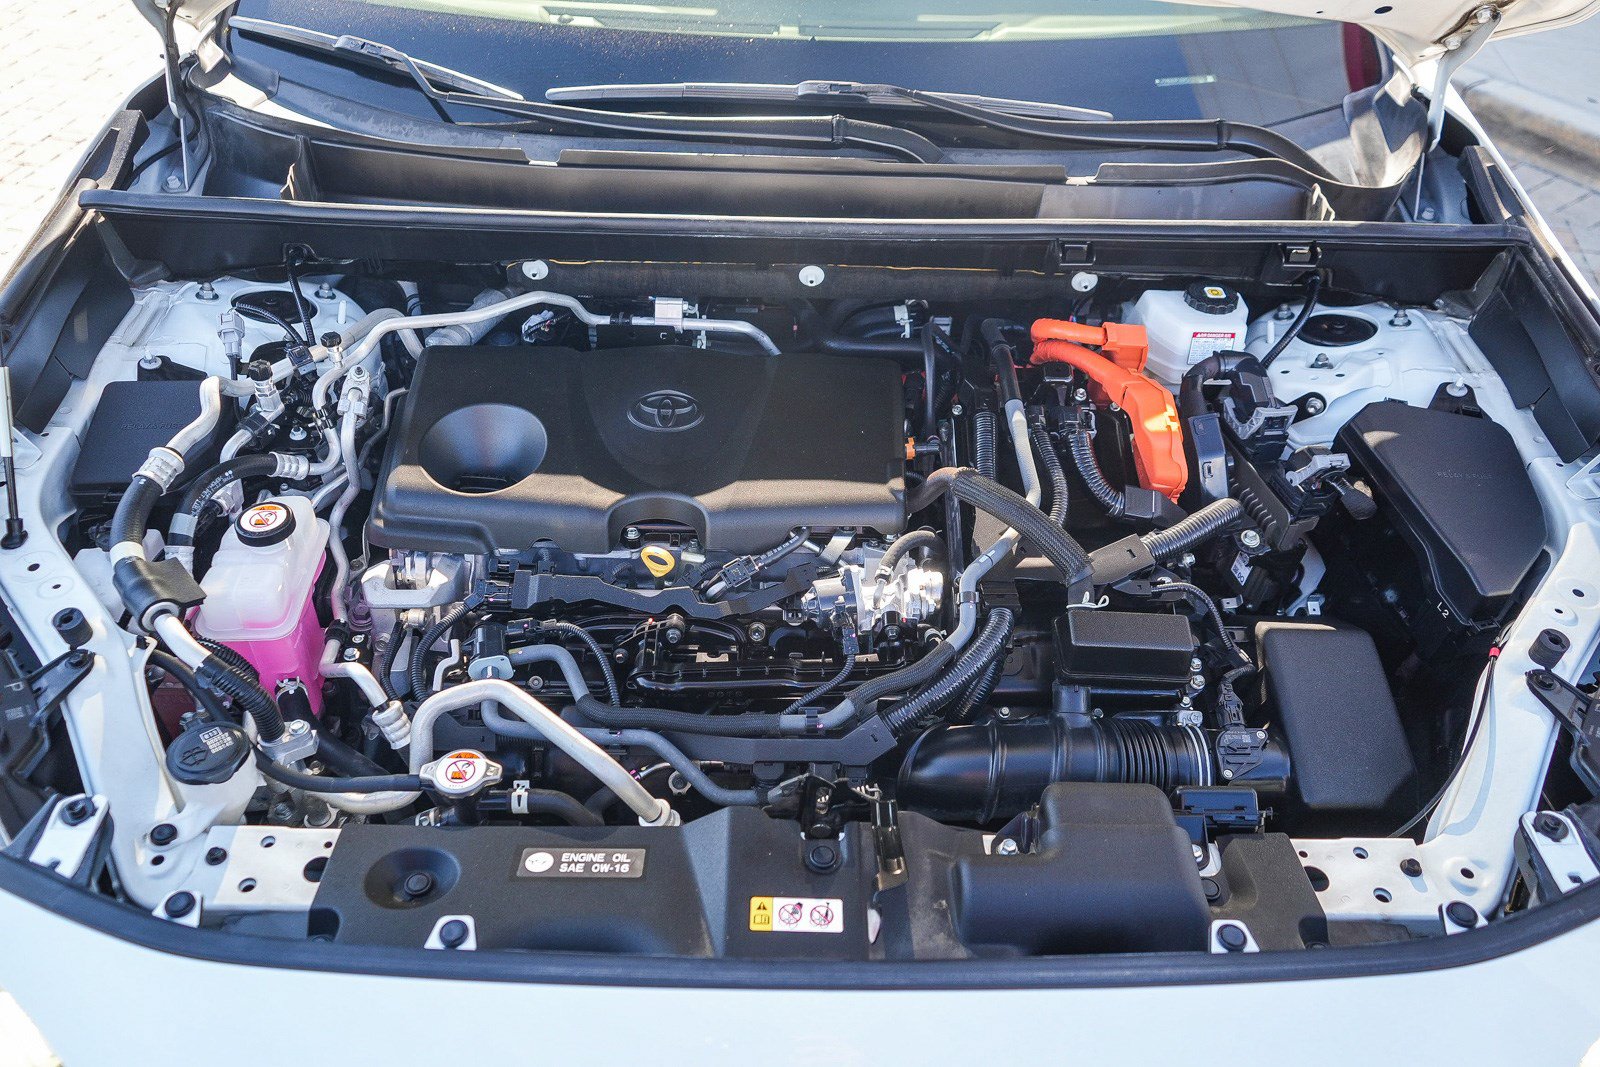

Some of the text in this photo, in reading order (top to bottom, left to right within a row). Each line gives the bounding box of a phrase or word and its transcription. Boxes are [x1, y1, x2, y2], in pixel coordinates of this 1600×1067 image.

[1437, 602, 1449, 618] L2
[561, 853, 631, 862] ENGINE OIL
[559, 863, 630, 873] SAE 0W-16
